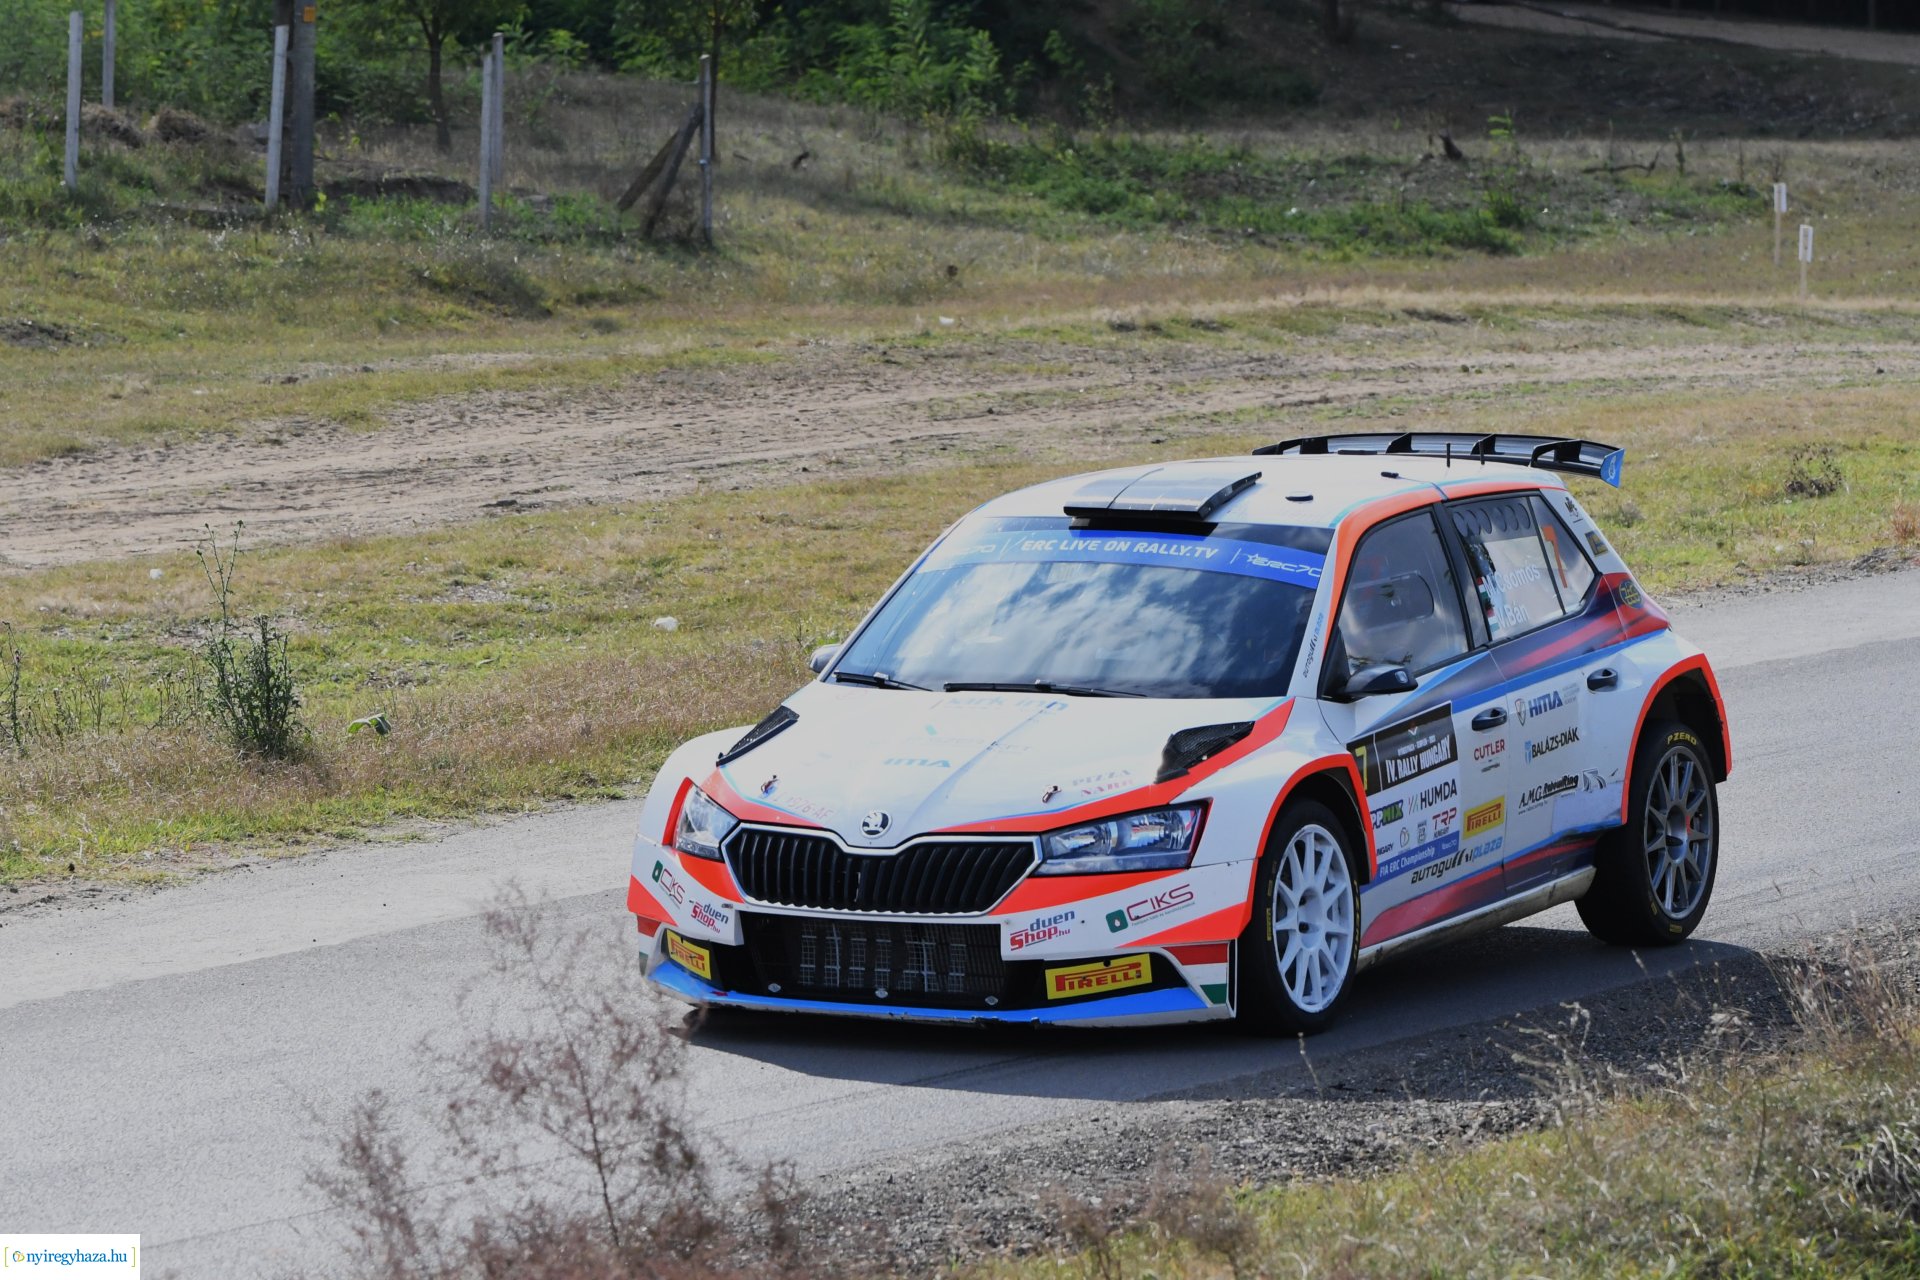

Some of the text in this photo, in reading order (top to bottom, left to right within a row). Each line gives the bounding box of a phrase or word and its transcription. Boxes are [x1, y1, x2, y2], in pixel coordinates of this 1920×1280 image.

[1020, 539, 1220, 560] ERC LIVE ON RALLY.TV
[1541, 524, 1569, 590] 7
[1397, 754, 1420, 780] RALLY
[1420, 734, 1452, 771] HUNGARY
[1473, 738, 1506, 761] CUTLER
[1531, 726, 1581, 759] BALÁZS-DIÁK
[1420, 778, 1458, 810] HUMDA
[1432, 806, 1457, 830] TRP
[1466, 802, 1503, 833] PIRELLI
[1379, 845, 1436, 878] FIA ERC Championship
[702, 903, 729, 925] duen
[1126, 883, 1195, 922] CIKS
[1029, 910, 1076, 933] duen
[1054, 961, 1143, 993] PIRELLI
